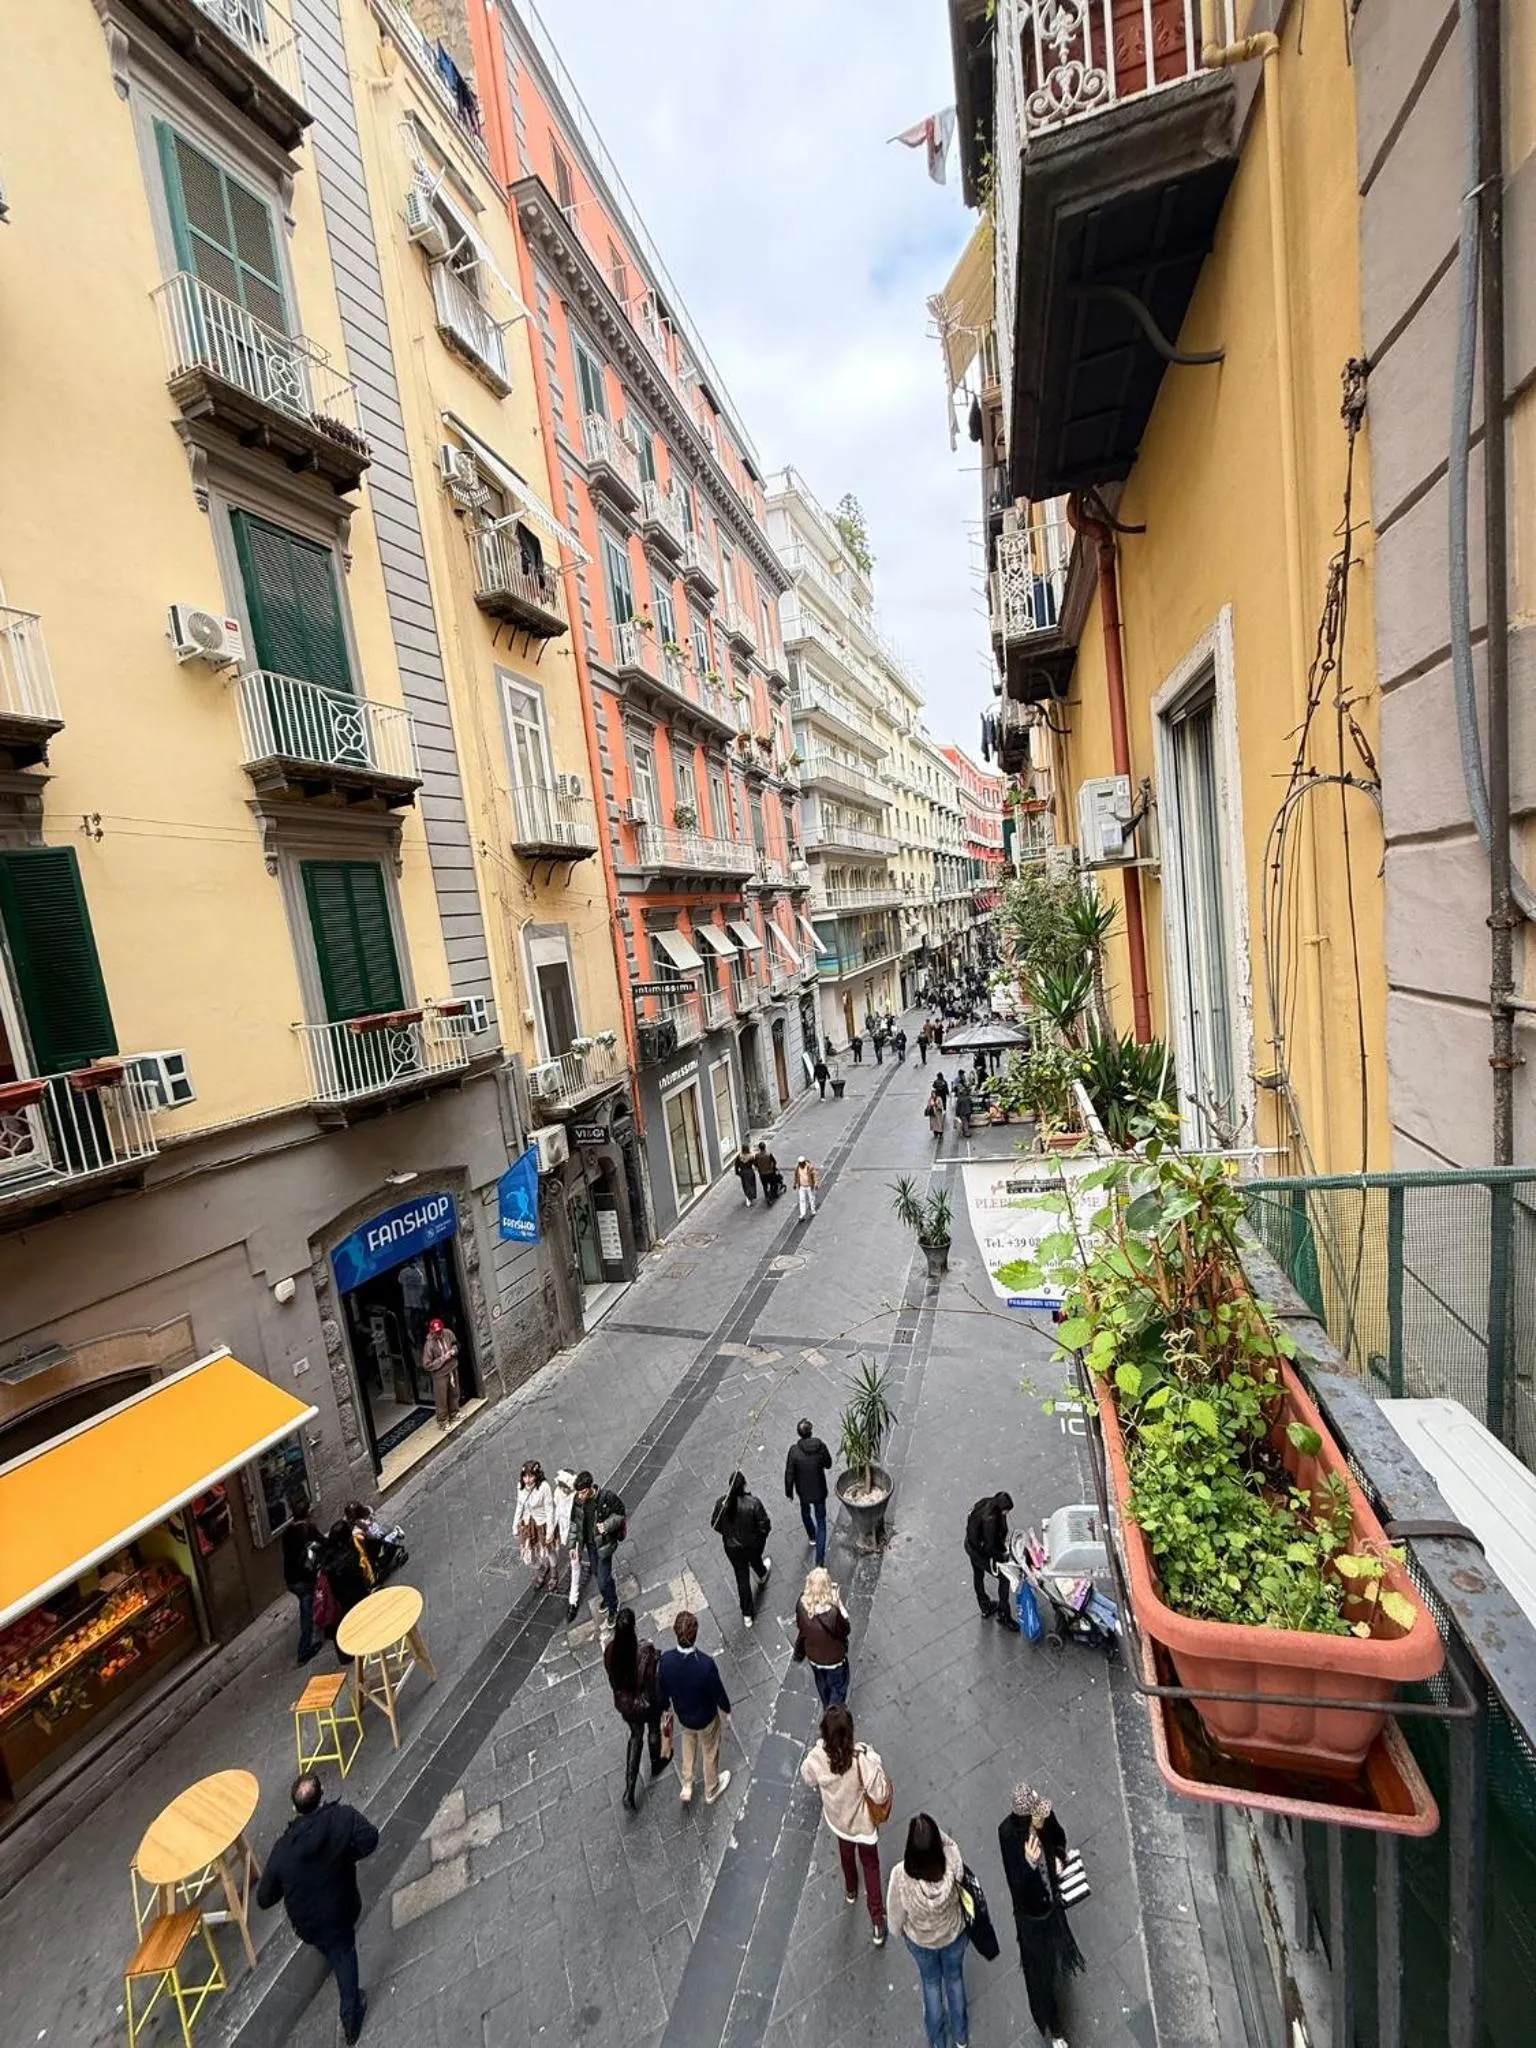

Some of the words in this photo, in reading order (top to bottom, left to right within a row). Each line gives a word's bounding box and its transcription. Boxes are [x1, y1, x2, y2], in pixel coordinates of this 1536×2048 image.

[635, 983, 692, 994] intimissimi
[367, 1196, 449, 1252] FANSHOP
[503, 1216, 535, 1232] FANSHOP
